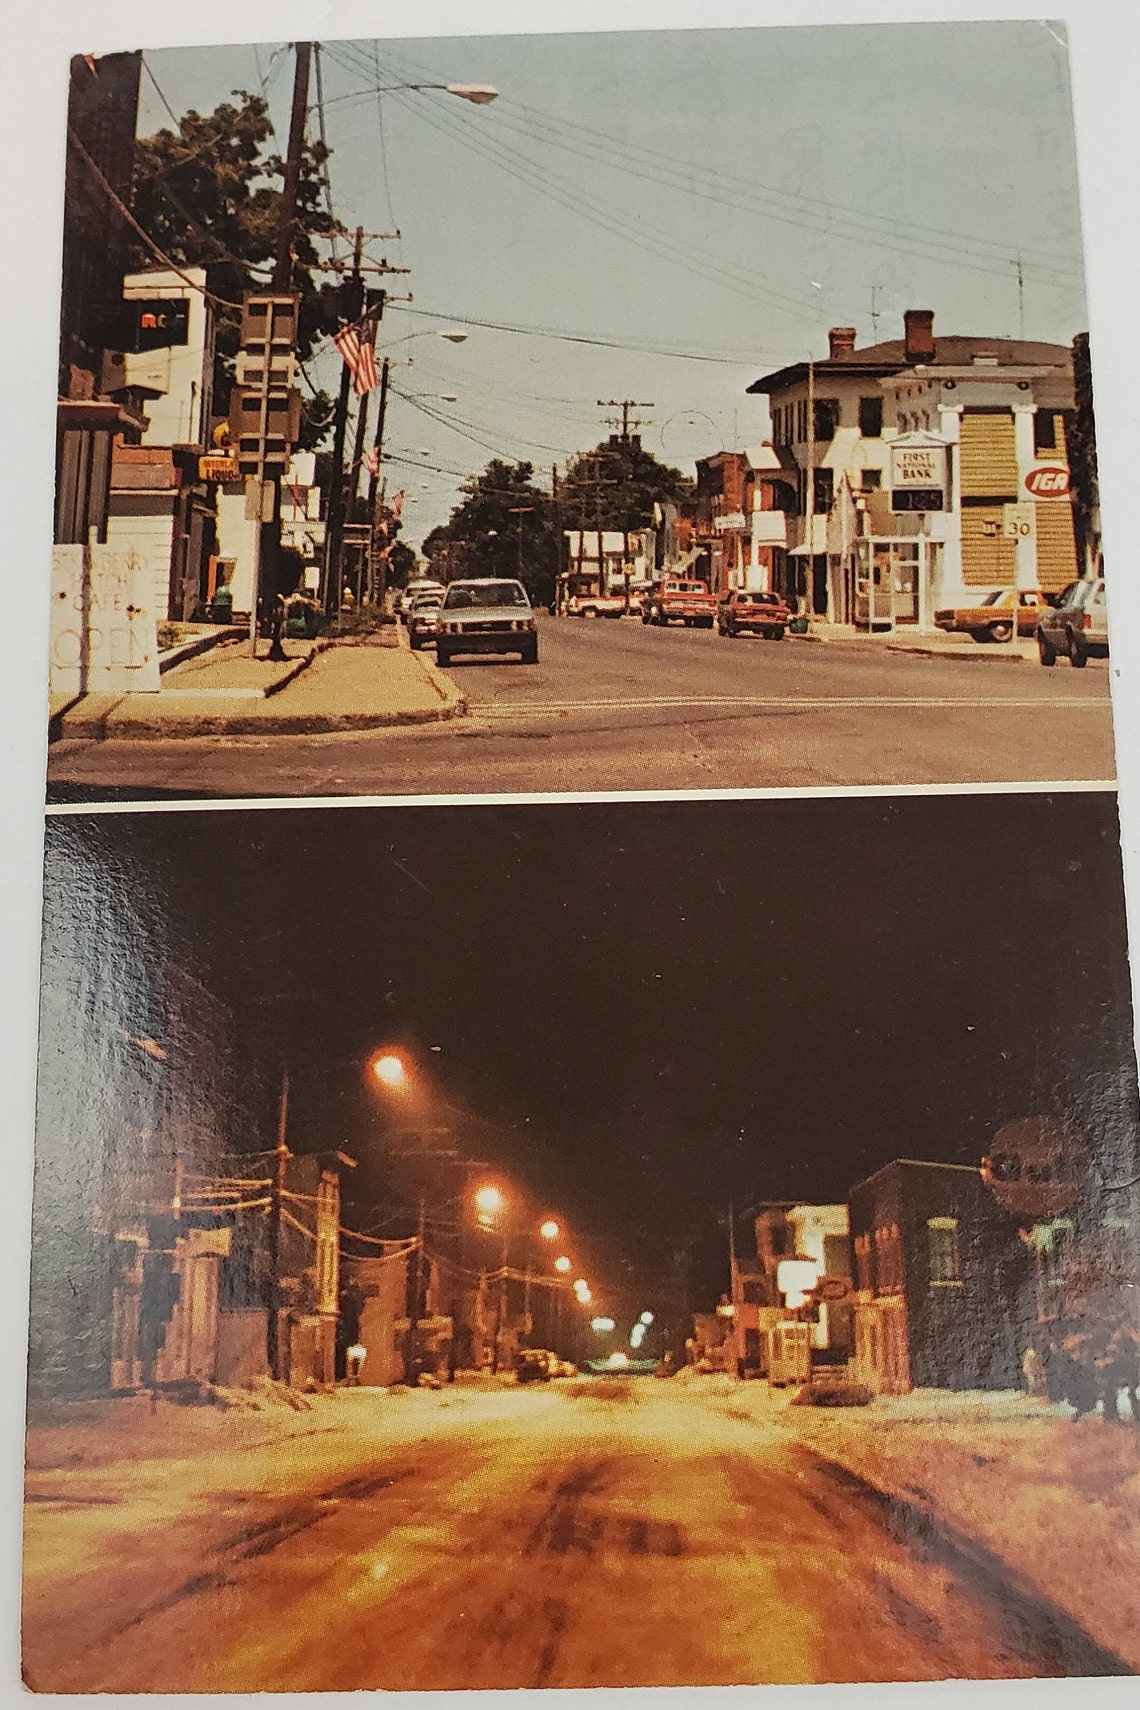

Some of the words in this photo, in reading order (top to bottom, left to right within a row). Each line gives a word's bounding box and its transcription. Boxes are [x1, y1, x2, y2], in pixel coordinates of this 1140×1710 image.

[903, 452, 931, 461] FIRST
[902, 469, 932, 479] BANK
[1030, 472, 1070, 491] IGA
[1007, 522, 1031, 536] 30
[55, 627, 148, 664] OPEN
